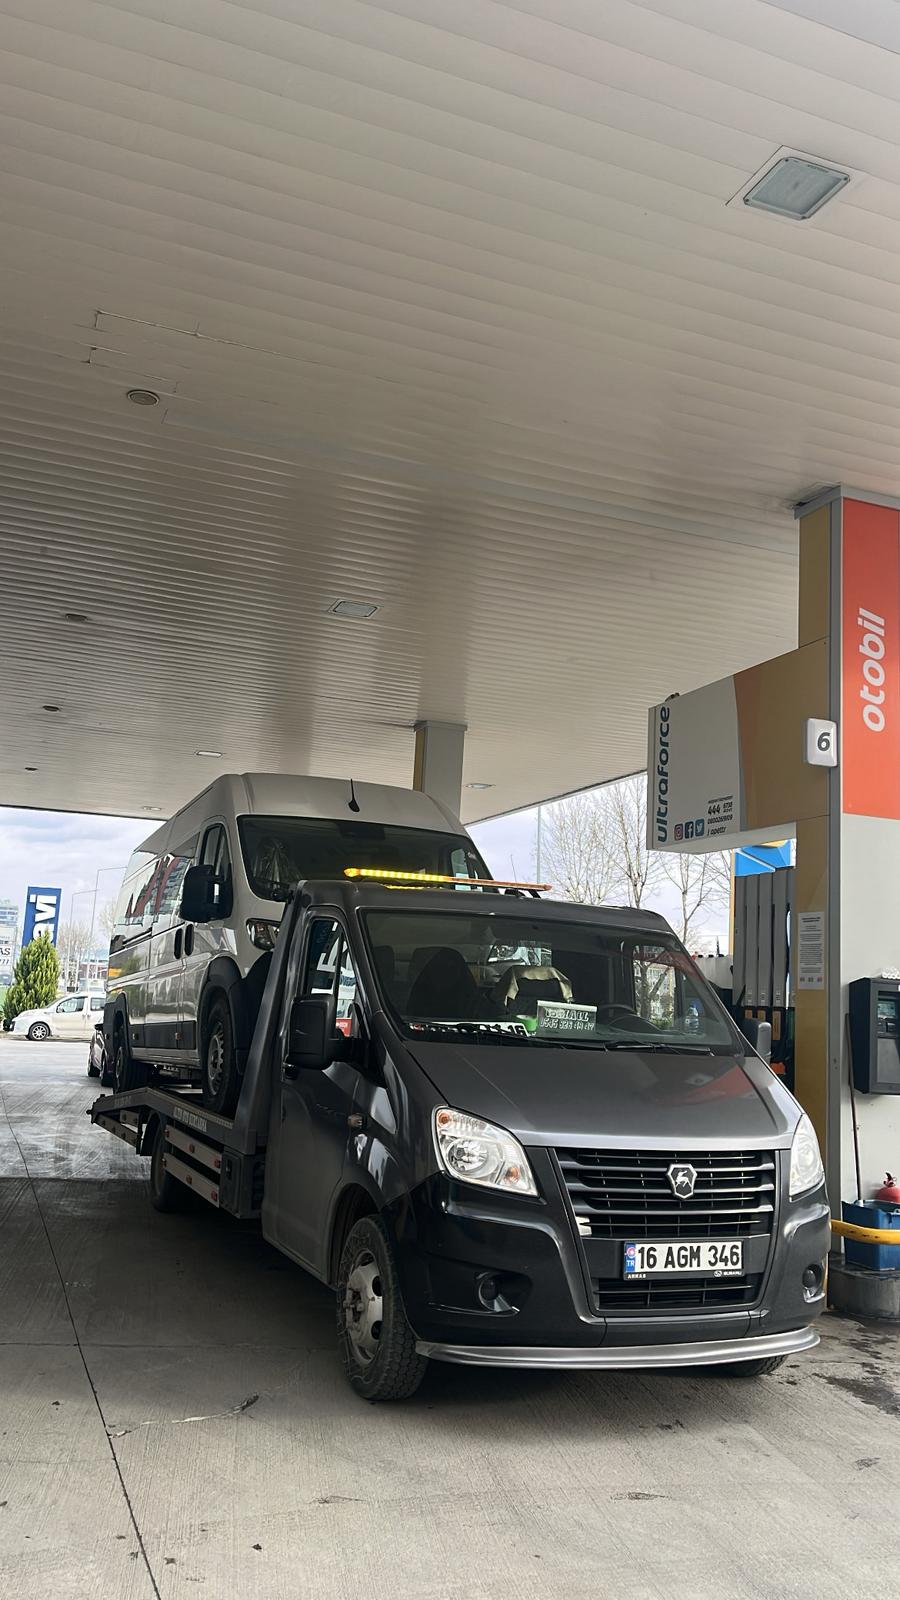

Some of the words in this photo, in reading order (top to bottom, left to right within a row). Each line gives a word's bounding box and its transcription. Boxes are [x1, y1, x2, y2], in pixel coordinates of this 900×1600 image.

[858, 607, 885, 732] otobil
[817, 732, 831, 752] 6
[656, 706, 670, 843] ultraforce
[707, 804, 721, 815] 444
[638, 1246, 657, 1269] 16
[664, 1245, 701, 1268] AGM
[708, 1244, 740, 1267] 346
